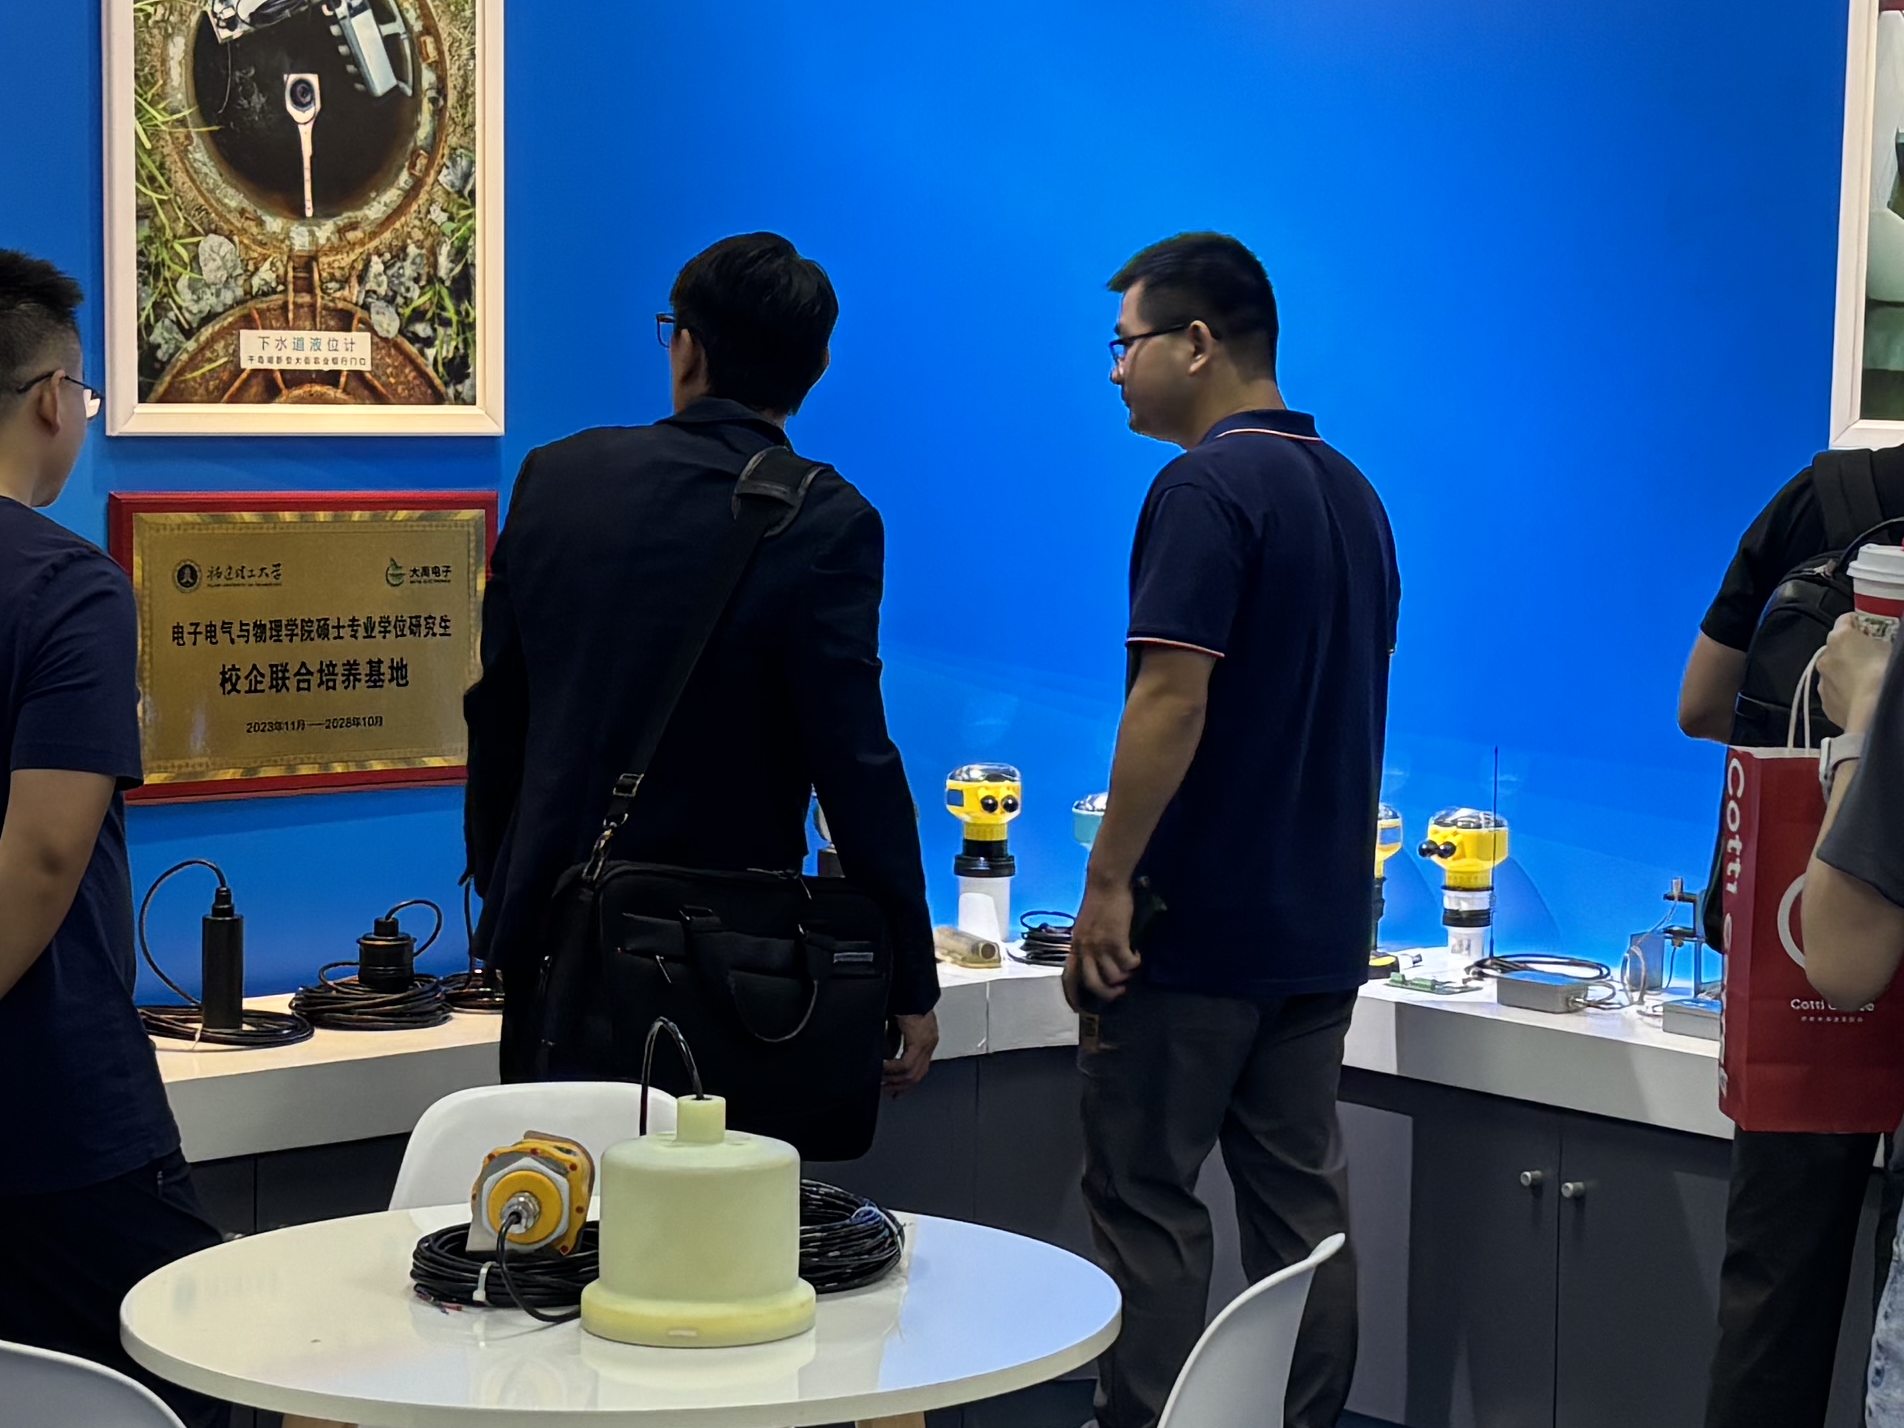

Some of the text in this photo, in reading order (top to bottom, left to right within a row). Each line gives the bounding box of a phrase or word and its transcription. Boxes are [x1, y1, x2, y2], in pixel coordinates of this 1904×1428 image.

[258, 335, 357, 353] 下水道液位计
[219, 657, 409, 696] 校企联合培养基地
[1790, 998, 1825, 1010] Cotti
